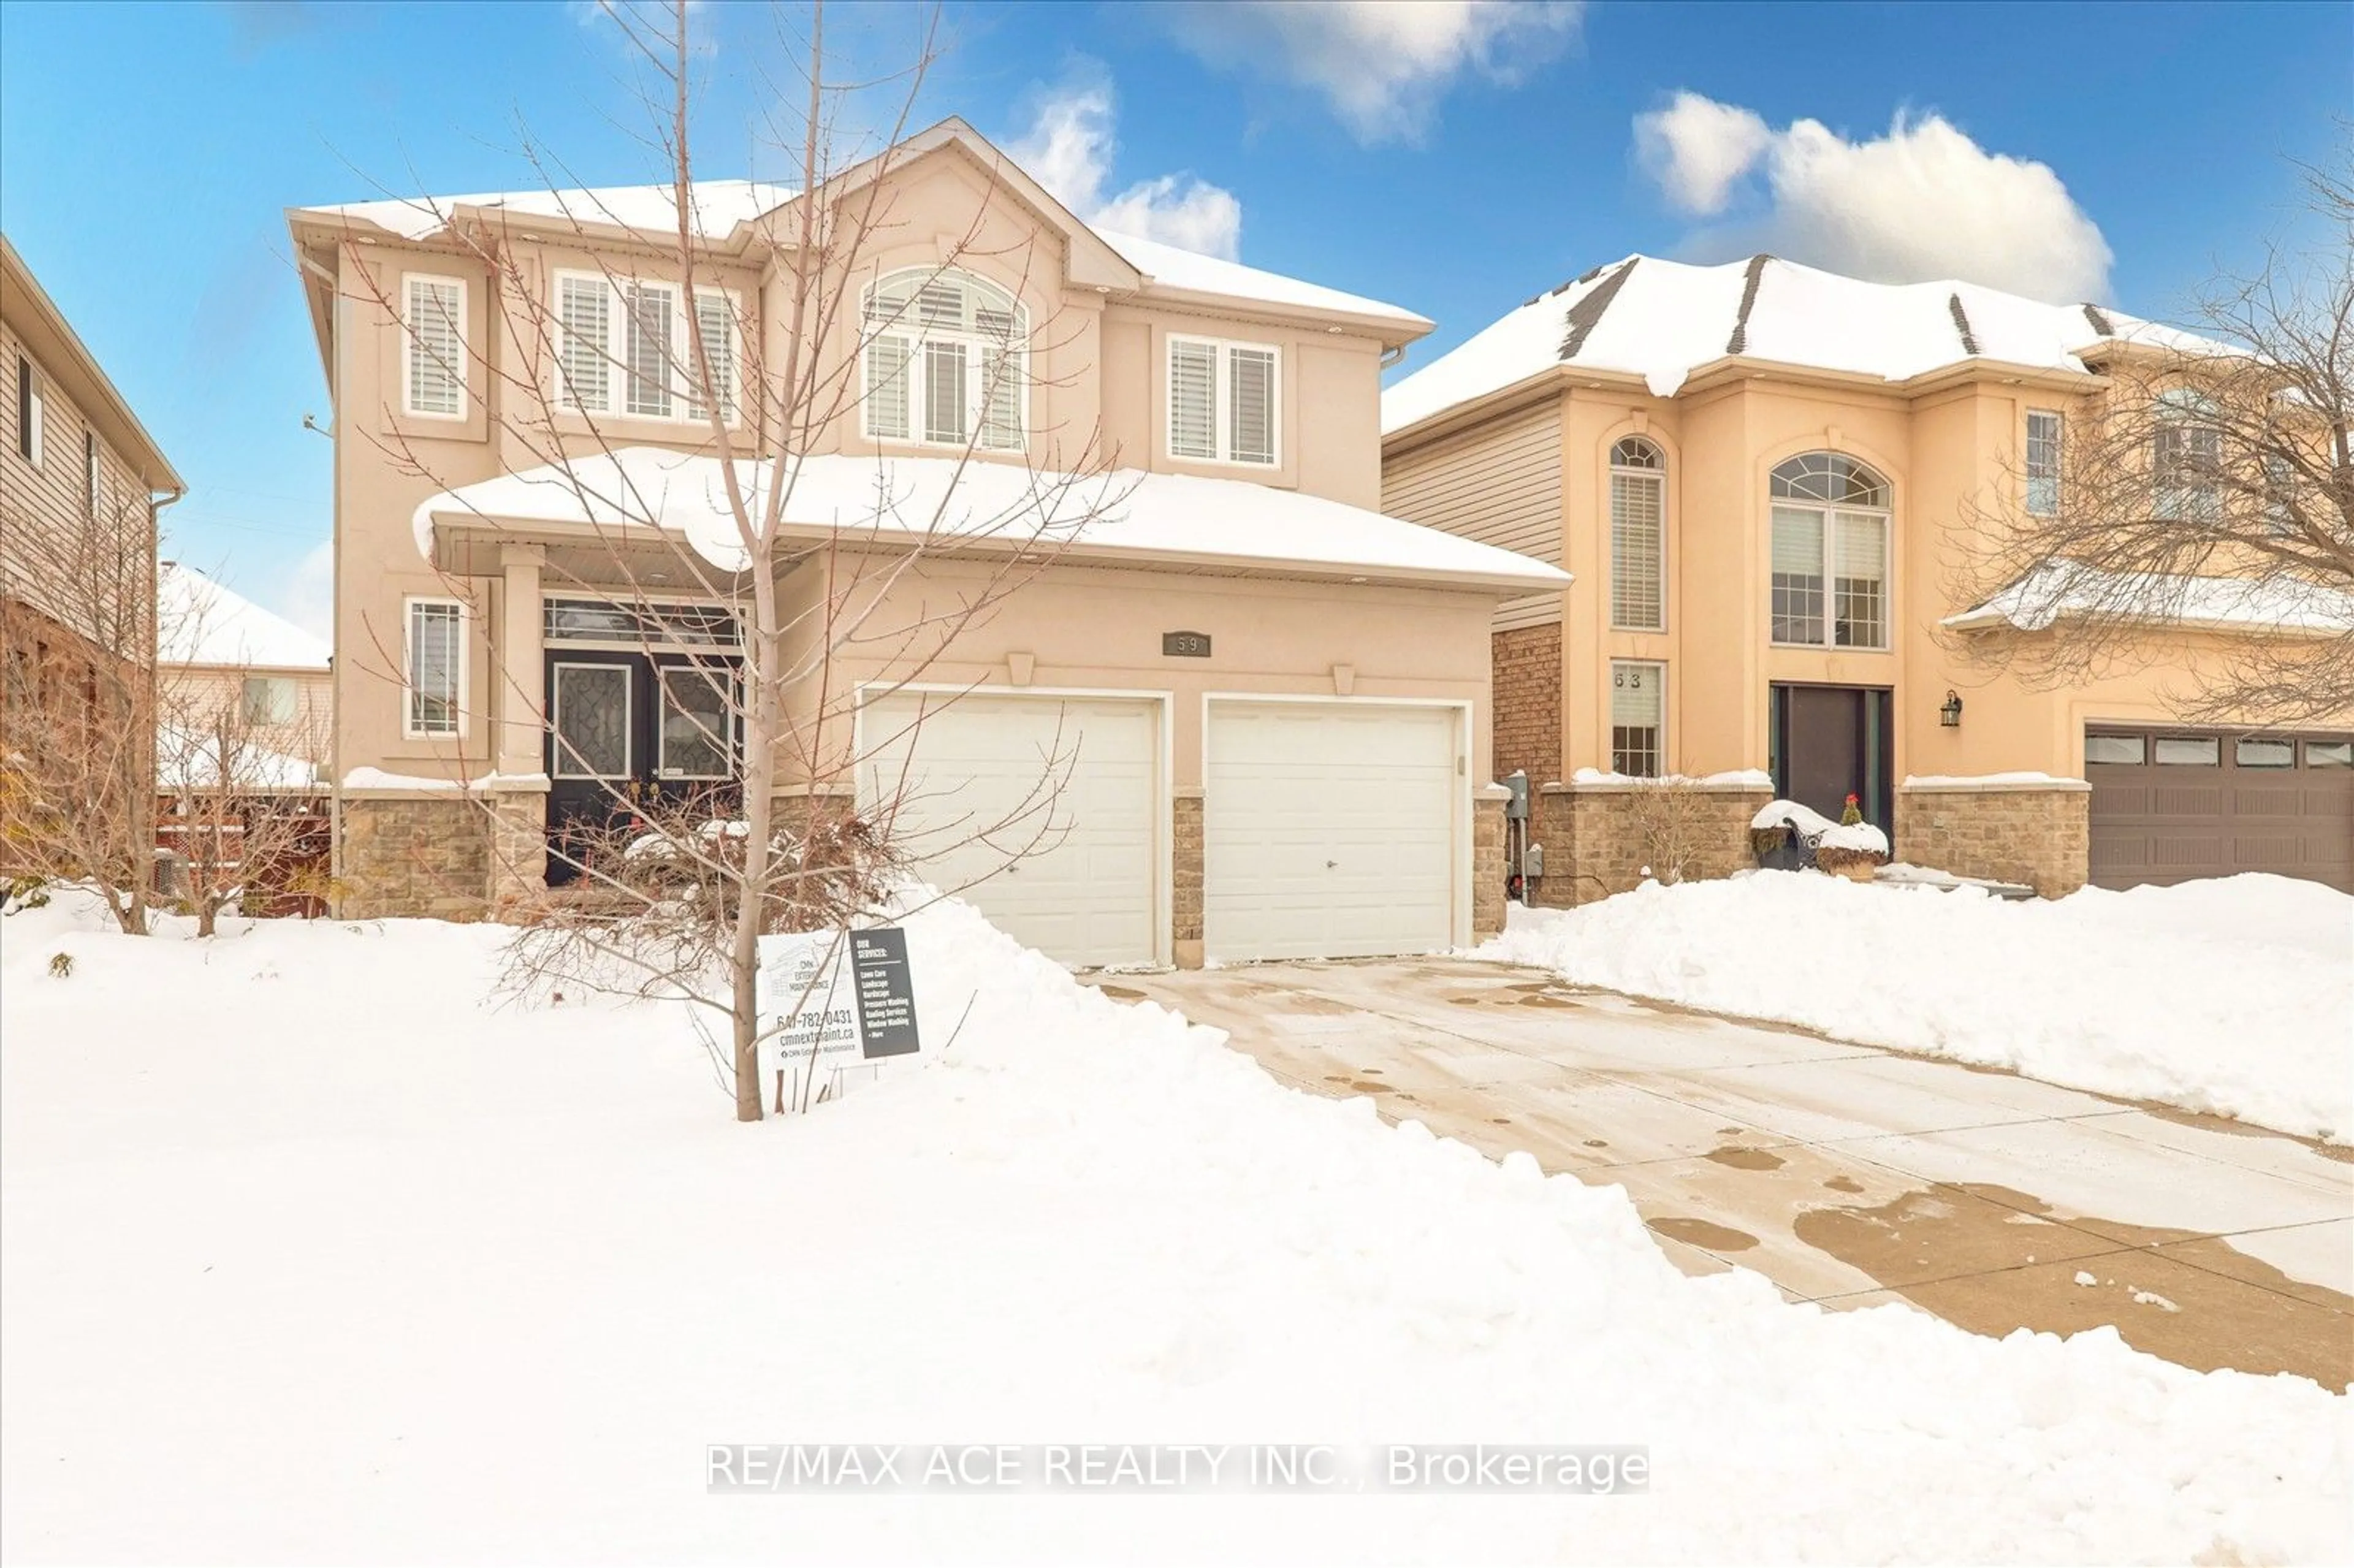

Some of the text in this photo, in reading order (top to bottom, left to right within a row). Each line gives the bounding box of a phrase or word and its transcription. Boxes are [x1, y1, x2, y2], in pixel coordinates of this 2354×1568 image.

[1178, 637, 1197, 651] 59
[1615, 673, 1641, 688] 63
[856, 939, 869, 949] OUR
